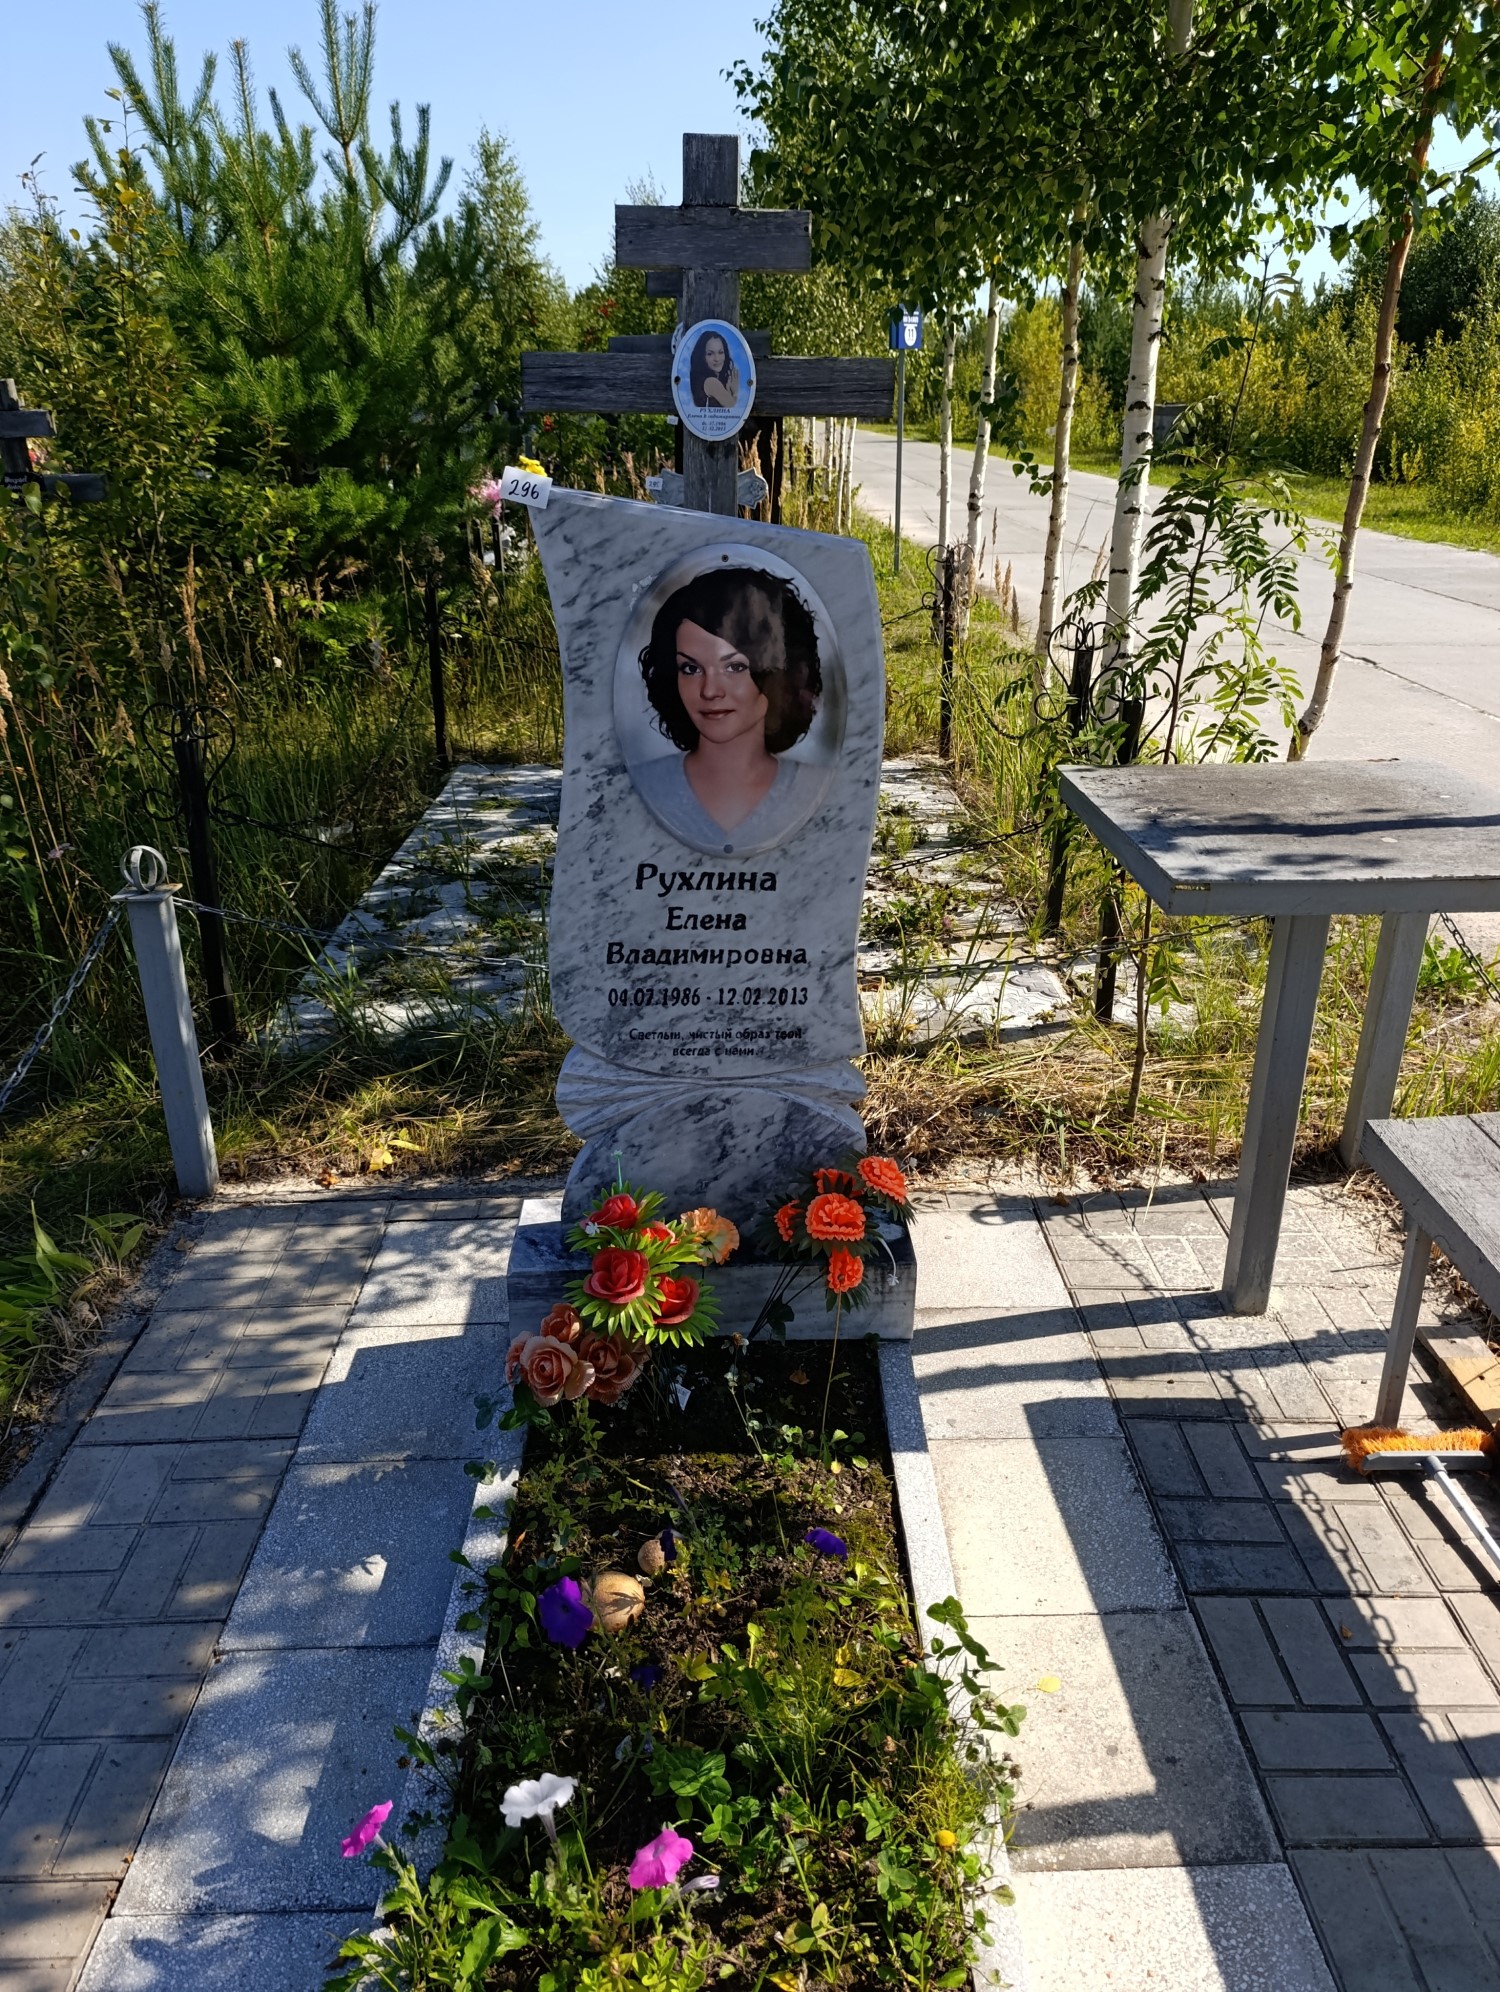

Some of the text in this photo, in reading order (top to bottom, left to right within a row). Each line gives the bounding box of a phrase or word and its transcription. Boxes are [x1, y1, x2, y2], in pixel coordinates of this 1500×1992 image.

[508, 479, 540, 500] 296
[635, 863, 778, 898] Рухлина
[665, 906, 748, 931] Елена
[606, 942, 808, 968] Владимировна
[607, 987, 701, 1007] 04.07.1986
[717, 987, 809, 1006] 12.02.2013
[735, 1028, 771, 1042] образ
[672, 1046, 712, 1057] всегда
[714, 1046, 721, 1057] с
